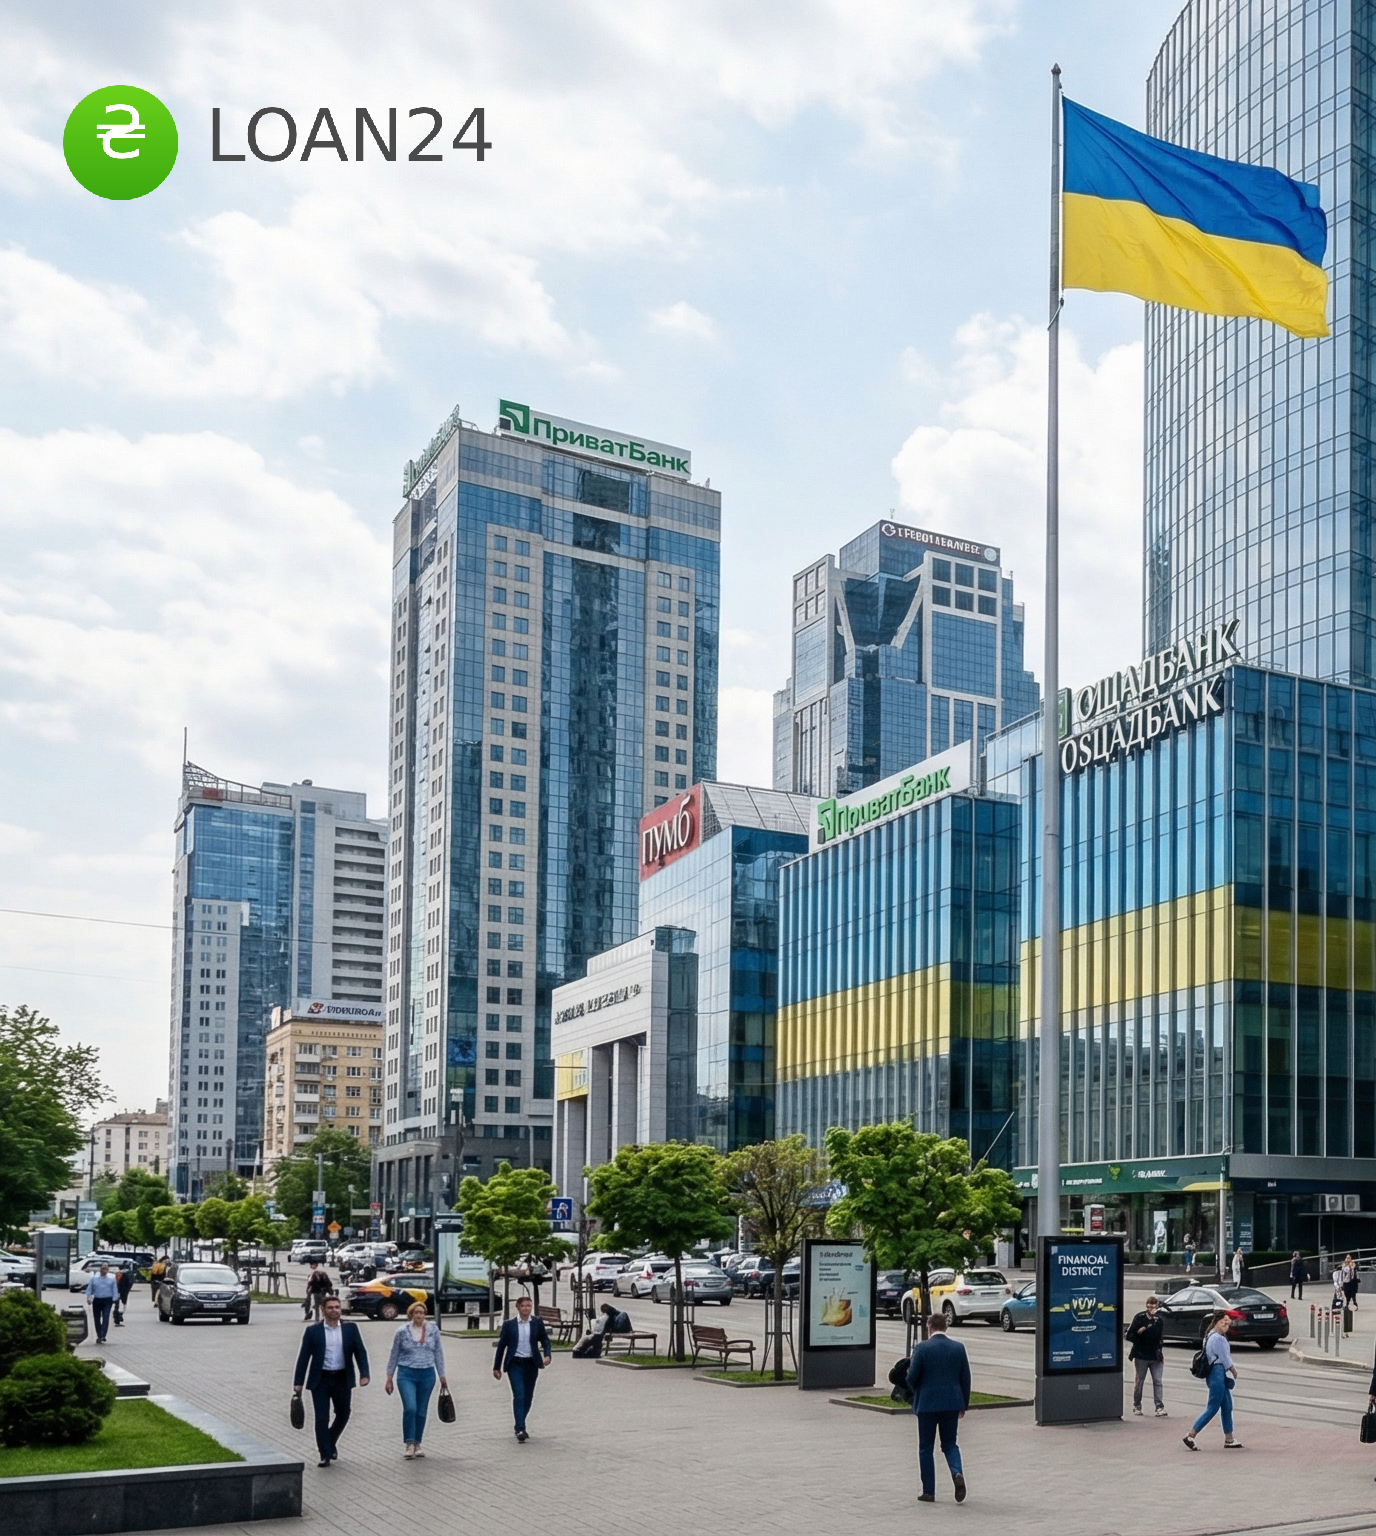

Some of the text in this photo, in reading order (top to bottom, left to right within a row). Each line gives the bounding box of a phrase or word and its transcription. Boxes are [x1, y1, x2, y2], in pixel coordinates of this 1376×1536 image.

[533, 416, 690, 474] ПриватБанк
[1076, 618, 1241, 720] ОЩАДБАНК
[1061, 1266, 1104, 1276] DISTRICT
